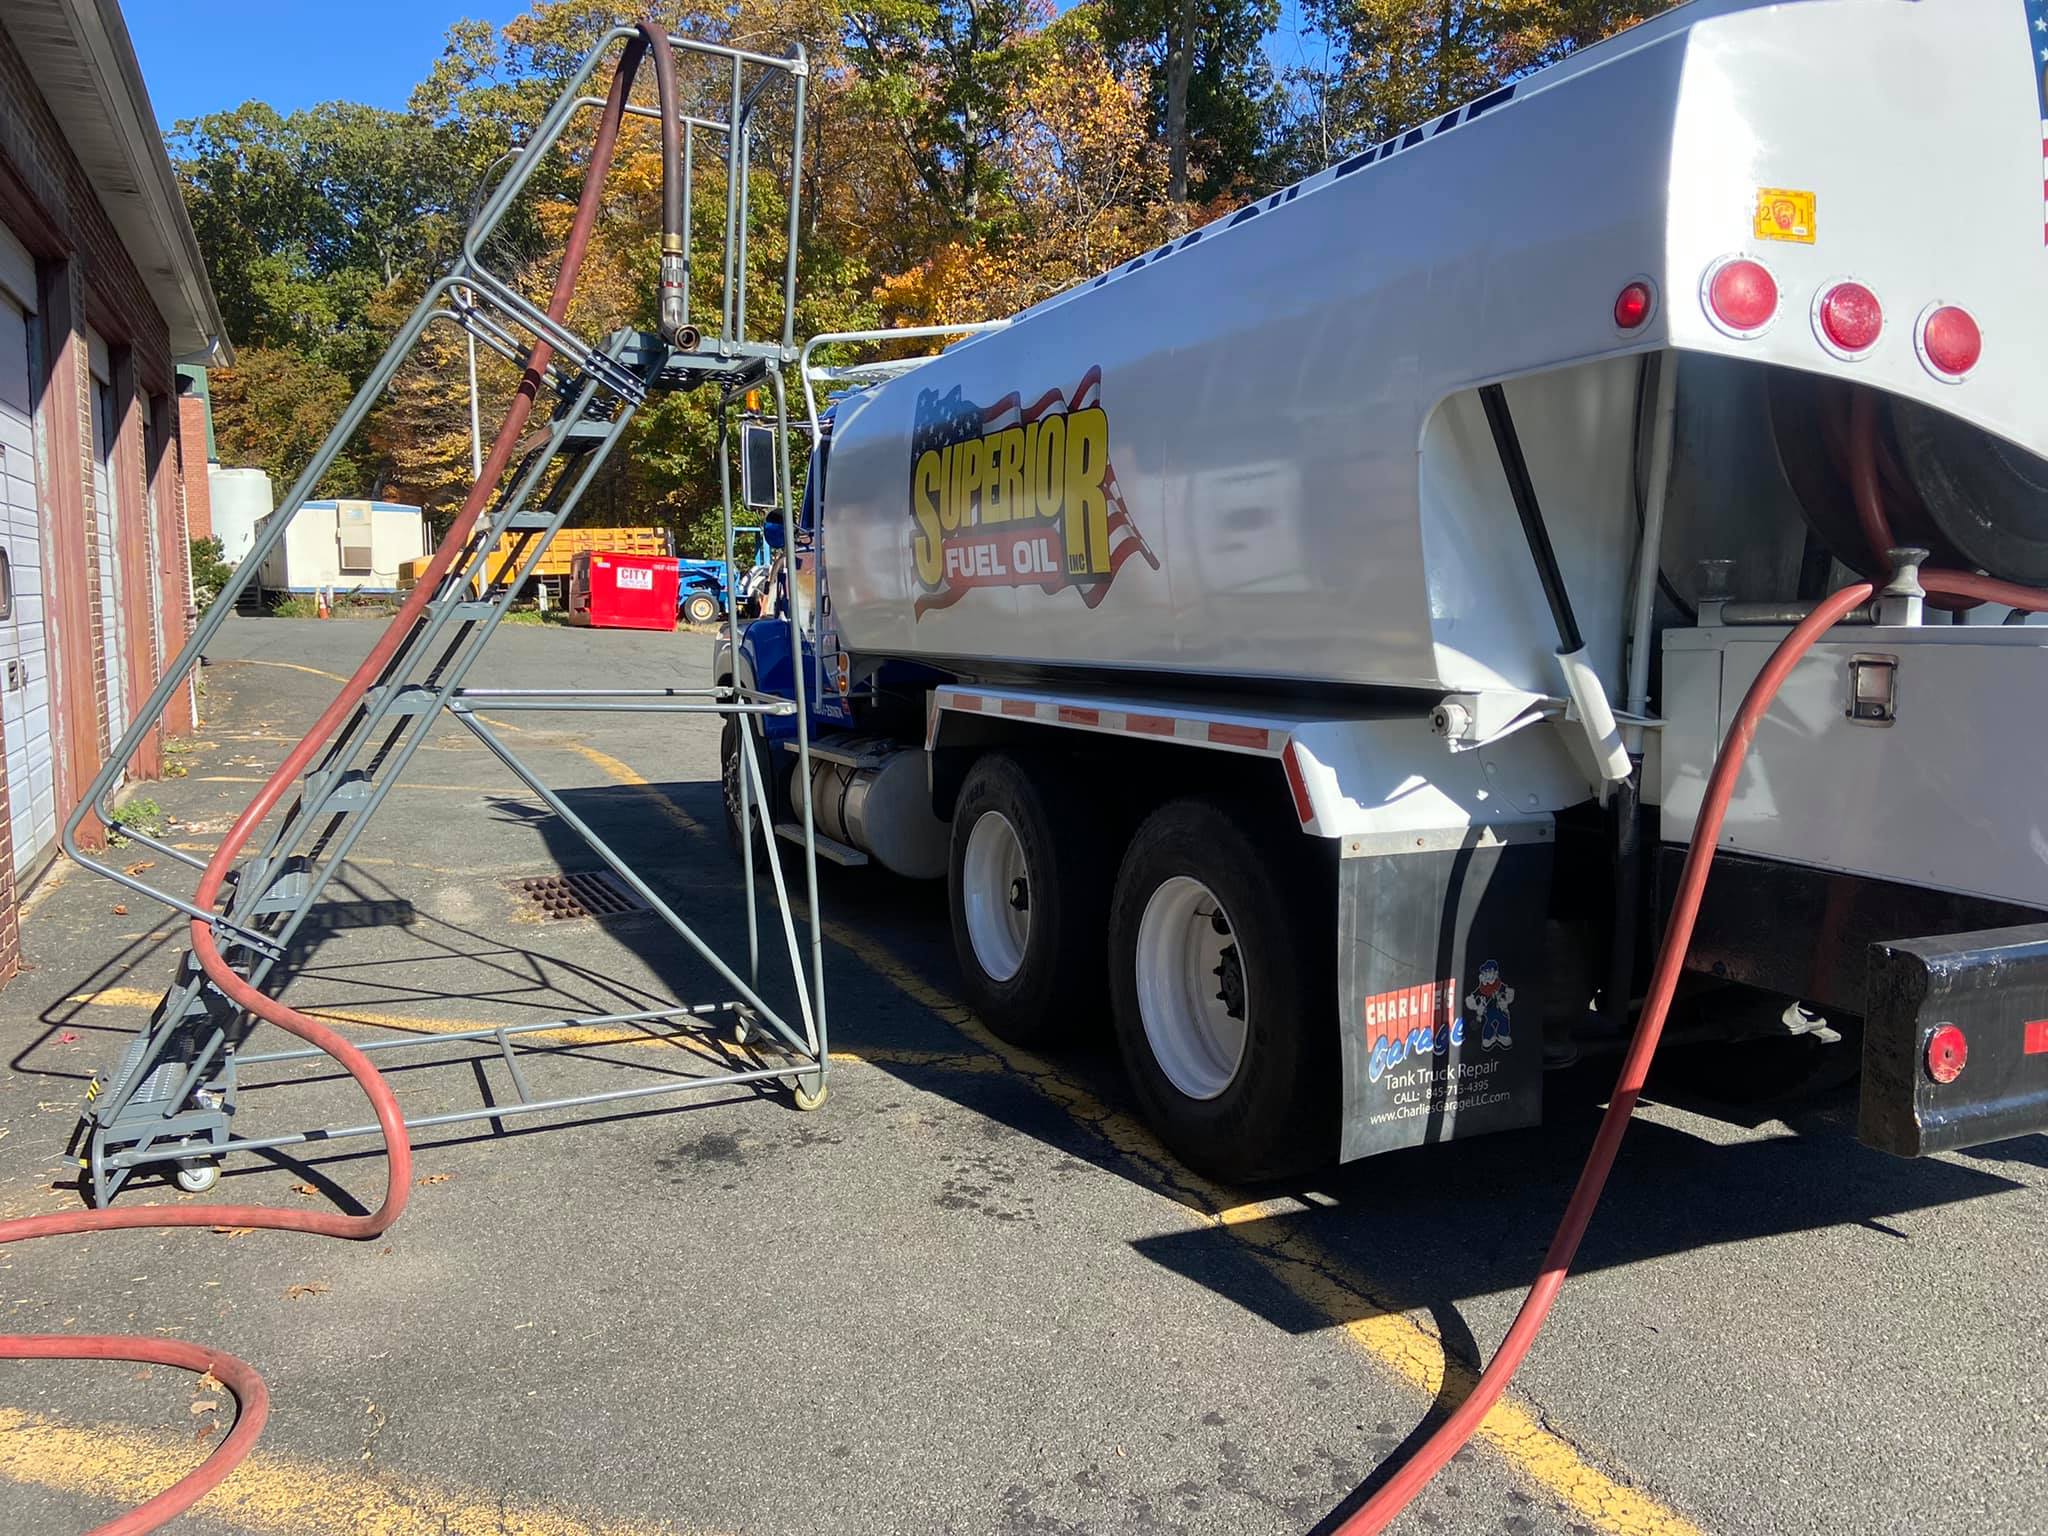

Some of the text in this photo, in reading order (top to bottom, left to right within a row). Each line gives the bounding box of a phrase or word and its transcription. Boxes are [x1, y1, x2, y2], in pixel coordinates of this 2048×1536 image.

[914, 408, 1111, 585] SUPERIOR
[621, 568, 648, 580] CITY
[946, 539, 1058, 578] FUEL OIL
[1069, 553, 1086, 573] INC
[1368, 1014, 1466, 1083] Garage
[1384, 1058, 1500, 1090] Tank Truck Repair
[1370, 1091, 1511, 1125] www.CharliesGarageLLC.com
[1393, 1091, 1421, 1104] CALL:
